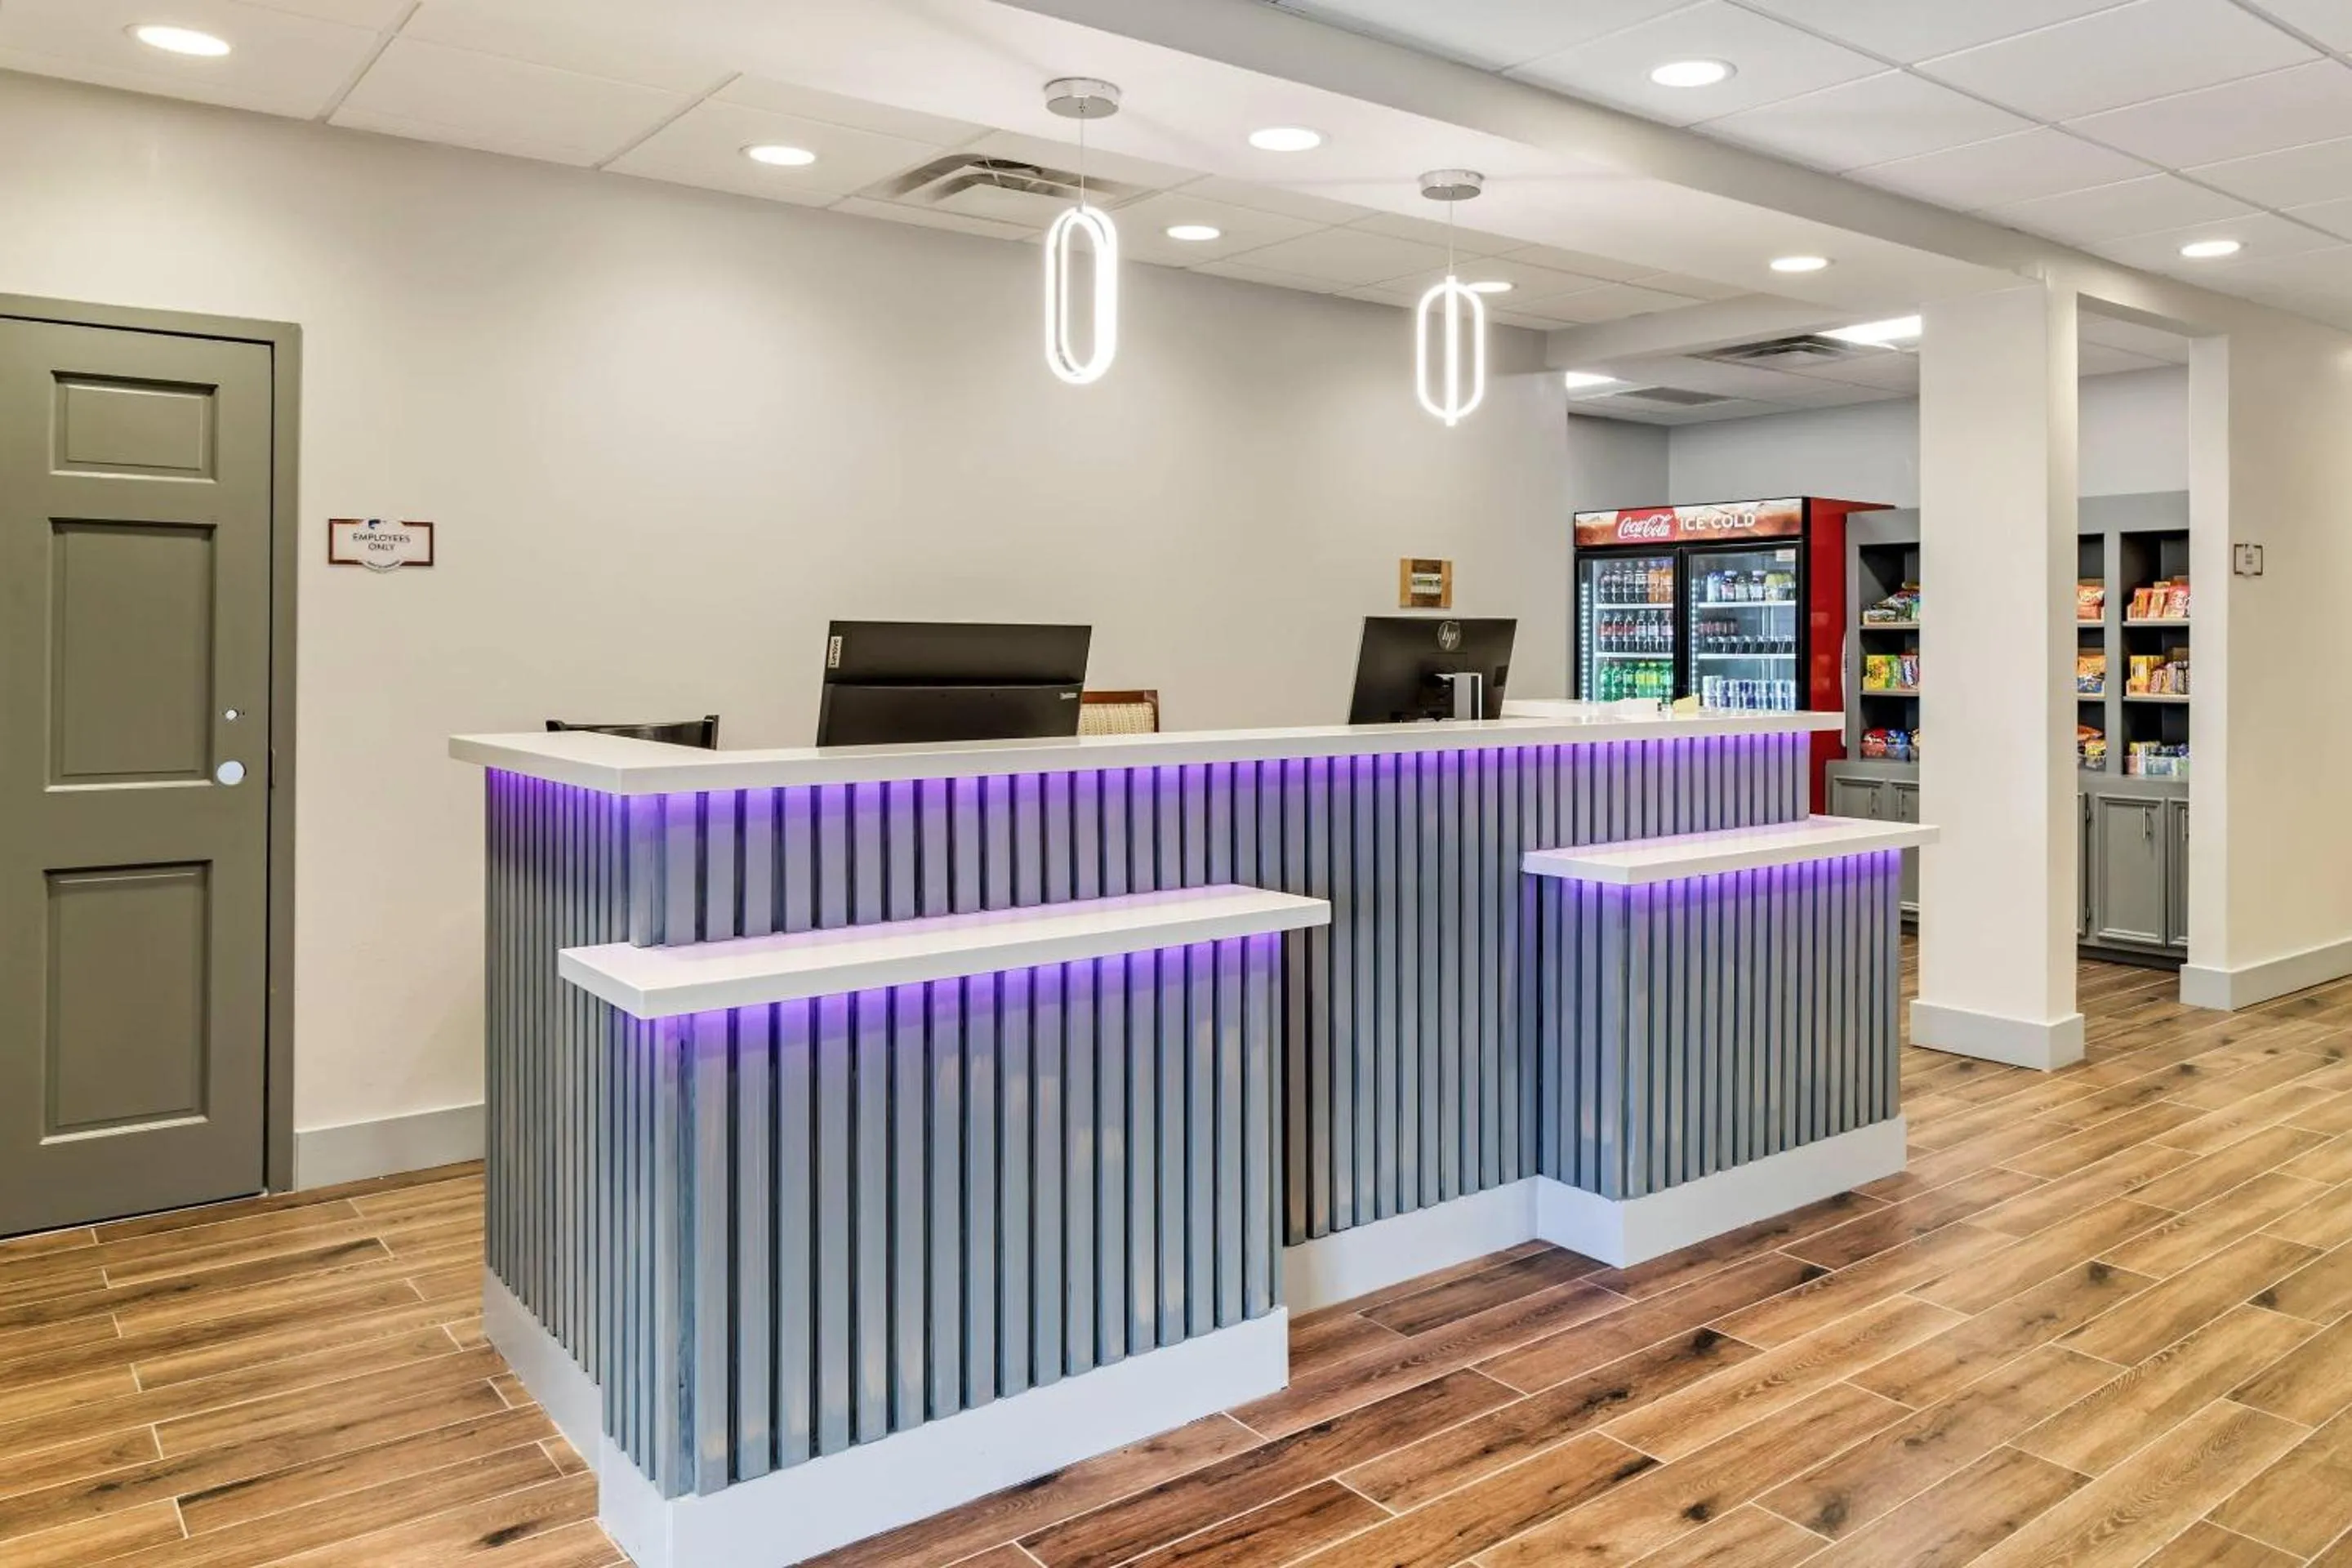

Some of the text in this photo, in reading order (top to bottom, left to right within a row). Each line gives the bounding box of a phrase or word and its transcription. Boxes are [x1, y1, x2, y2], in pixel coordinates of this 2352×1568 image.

[1680, 513, 1756, 531] ICE COLD
[352, 532, 411, 543] EMPLOYEES
[368, 542, 395, 551] ONLY
[1441, 625, 1456, 648] hp
